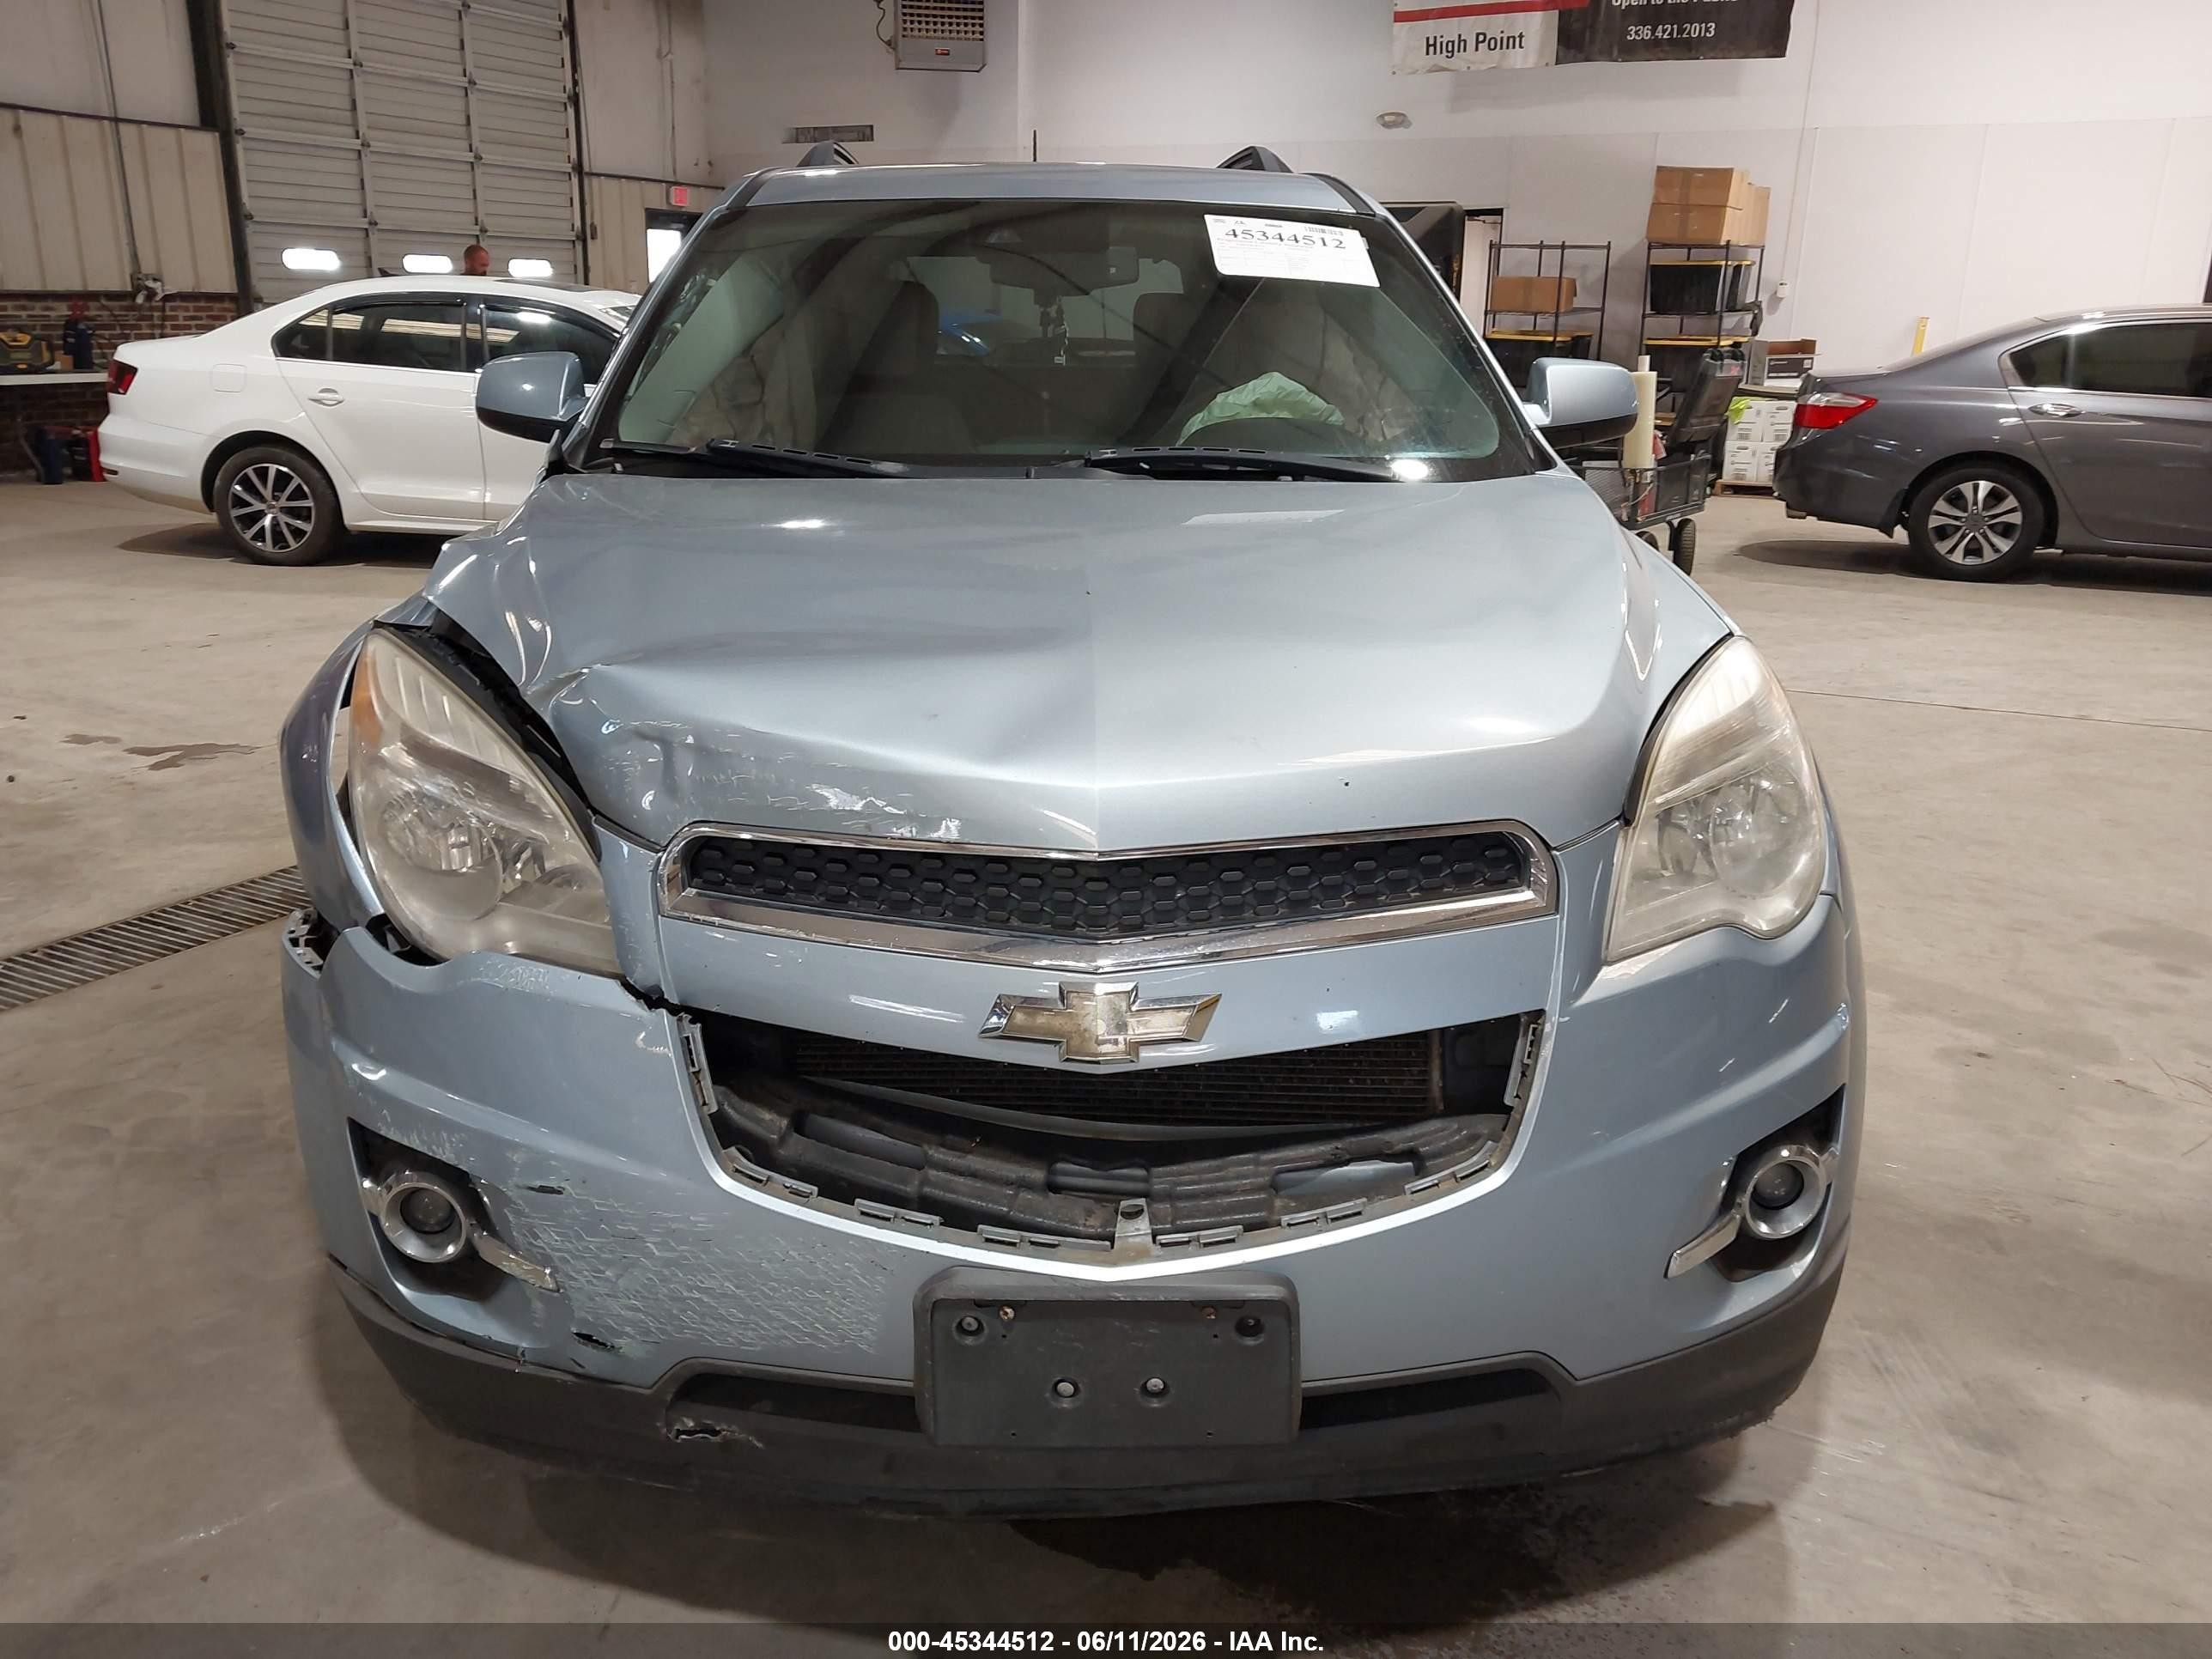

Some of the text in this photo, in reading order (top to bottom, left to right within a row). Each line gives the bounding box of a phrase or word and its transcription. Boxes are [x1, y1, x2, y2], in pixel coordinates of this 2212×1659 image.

[1626, 22, 1716, 40] 336.421.2013
[1425, 30, 1525, 59] High Point
[1224, 228, 1346, 249] 45344512
